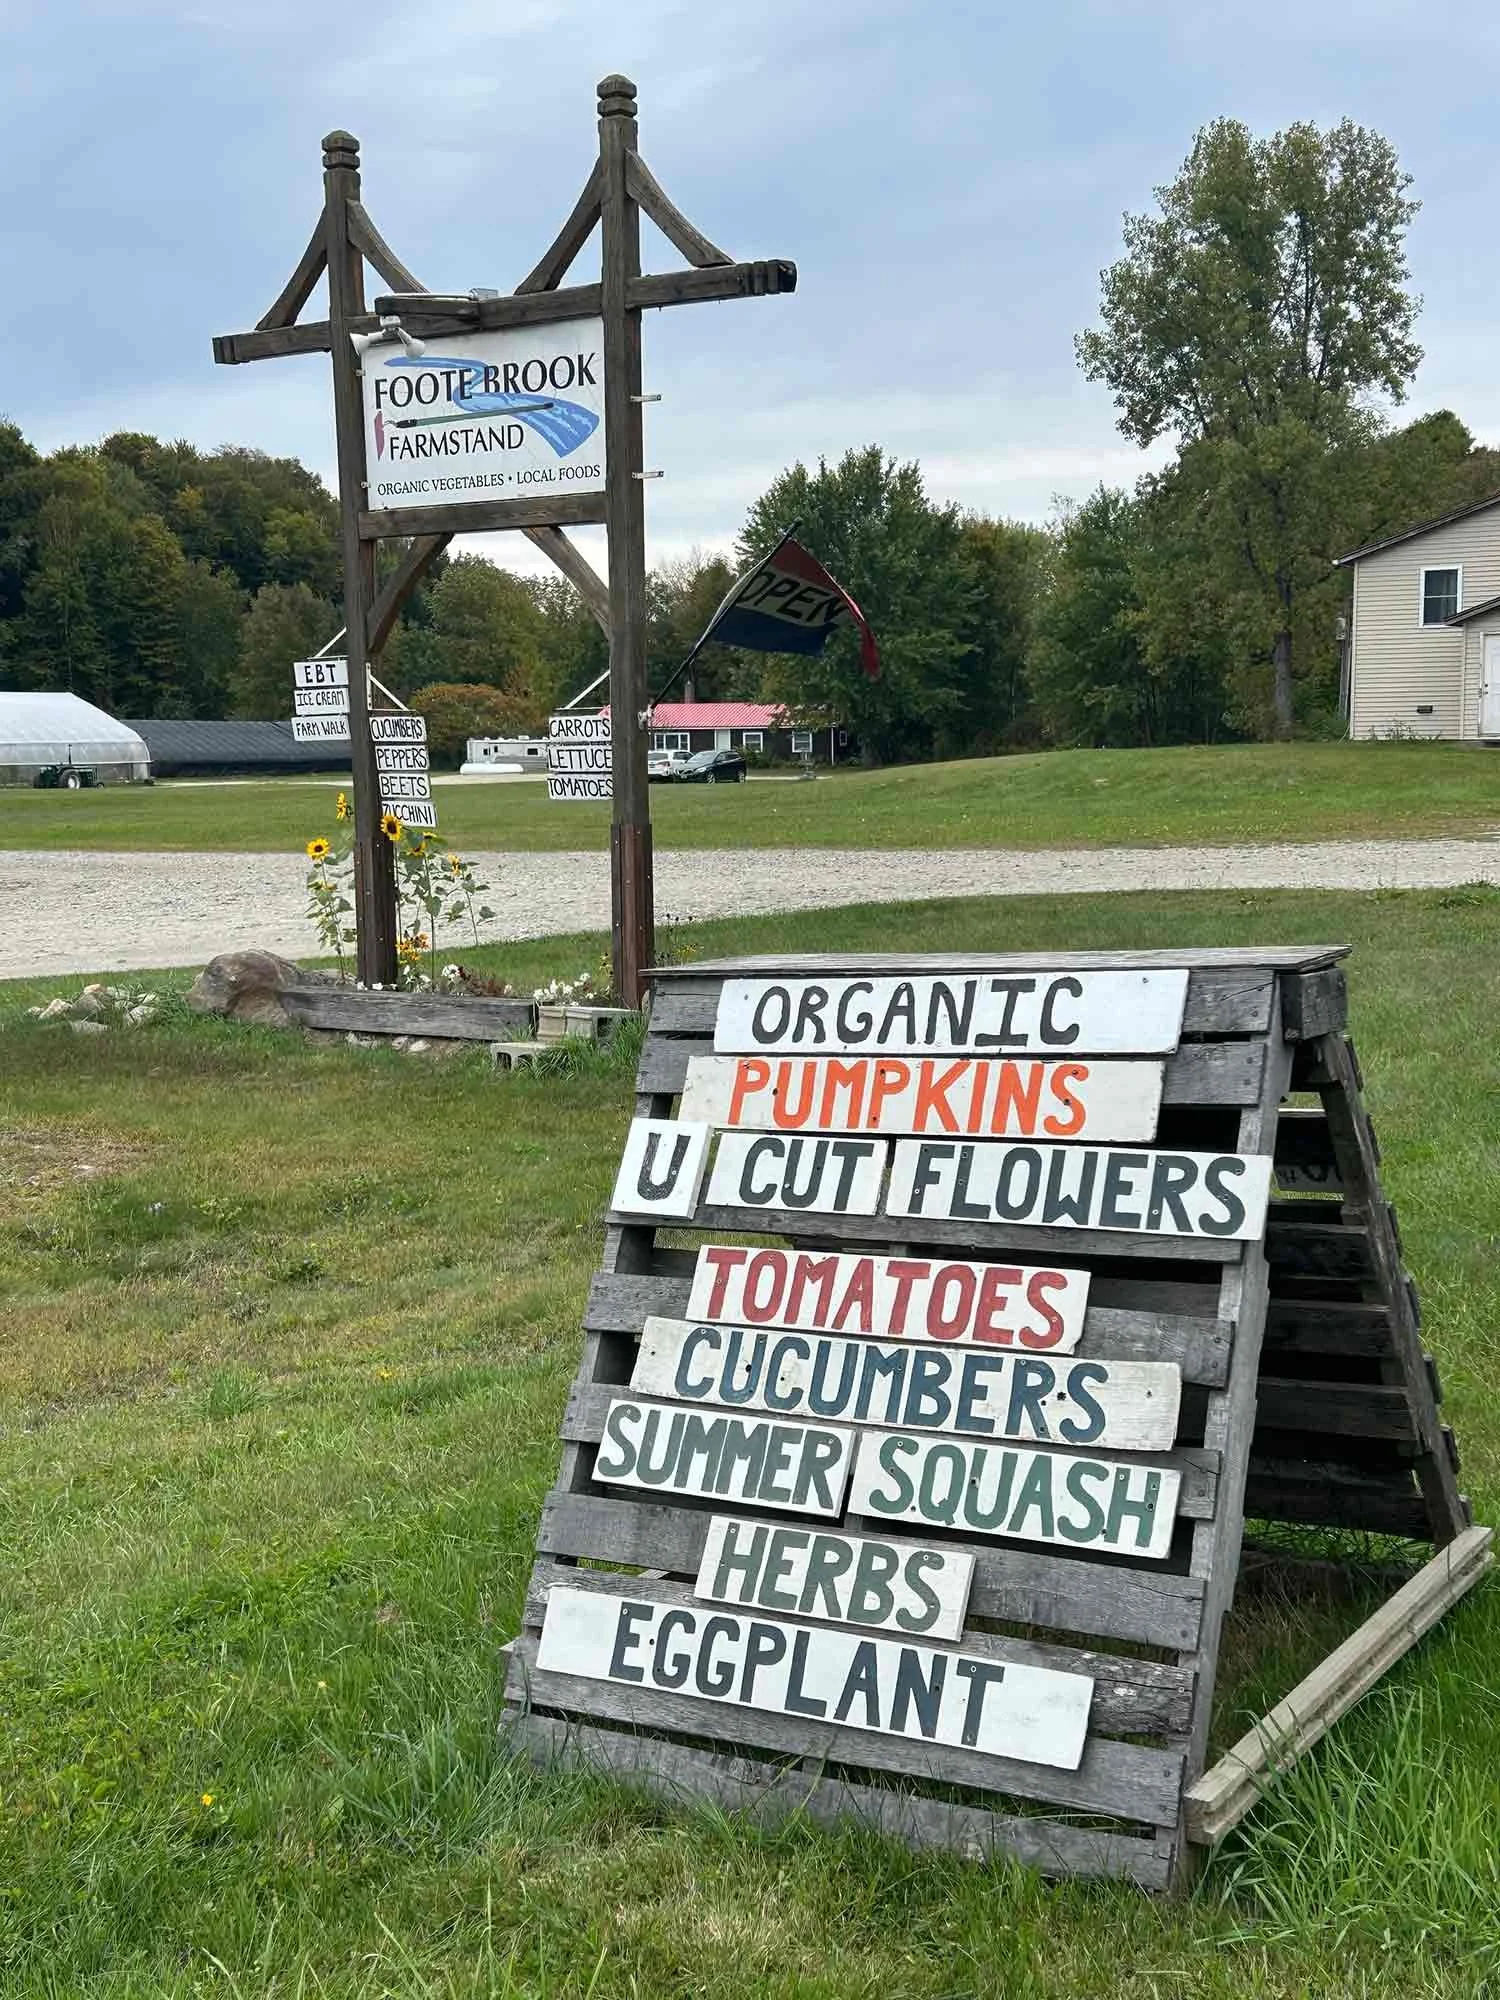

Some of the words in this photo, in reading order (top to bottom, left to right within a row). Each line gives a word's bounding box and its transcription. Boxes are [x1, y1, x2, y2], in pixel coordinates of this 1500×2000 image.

[374, 367, 473, 410] FOOTE
[483, 352, 597, 394] BROOK
[389, 423, 525, 462] FARMSTAND
[377, 479, 430, 496] ORGANIC
[431, 473, 504, 492] VEGETABLES
[516, 469, 556, 485] LOCAL
[558, 464, 601, 481] FOODS
[736, 571, 847, 623] OPEN
[304, 663, 336, 684] EBT
[296, 692, 315, 707] ICE
[316, 690, 345, 706] CREAM
[295, 722, 318, 737] FARM
[322, 720, 347, 736] WALK
[370, 718, 423, 740] CUCUMBERS
[549, 718, 612, 738] CARROTS
[376, 747, 428, 769] PEPPERS
[548, 748, 613, 769] LETTUCE
[380, 775, 428, 797] BEETS
[547, 778, 614, 797] TOMATOES
[751, 975, 1083, 1048] ORGANIC
[726, 1057, 1090, 1137] PUMPKINS
[636, 1131, 692, 1202] U
[738, 1131, 876, 1213] CUT
[906, 1141, 1248, 1238] FLOWERS
[705, 1247, 1069, 1350] TOMATOES
[674, 1326, 1110, 1444] CUCUMBERS
[597, 1403, 844, 1510] SUMMER
[867, 1435, 1163, 1549] SQUASH
[711, 1520, 945, 1633] HERBS
[607, 1600, 1005, 1746] EGGPLANT
